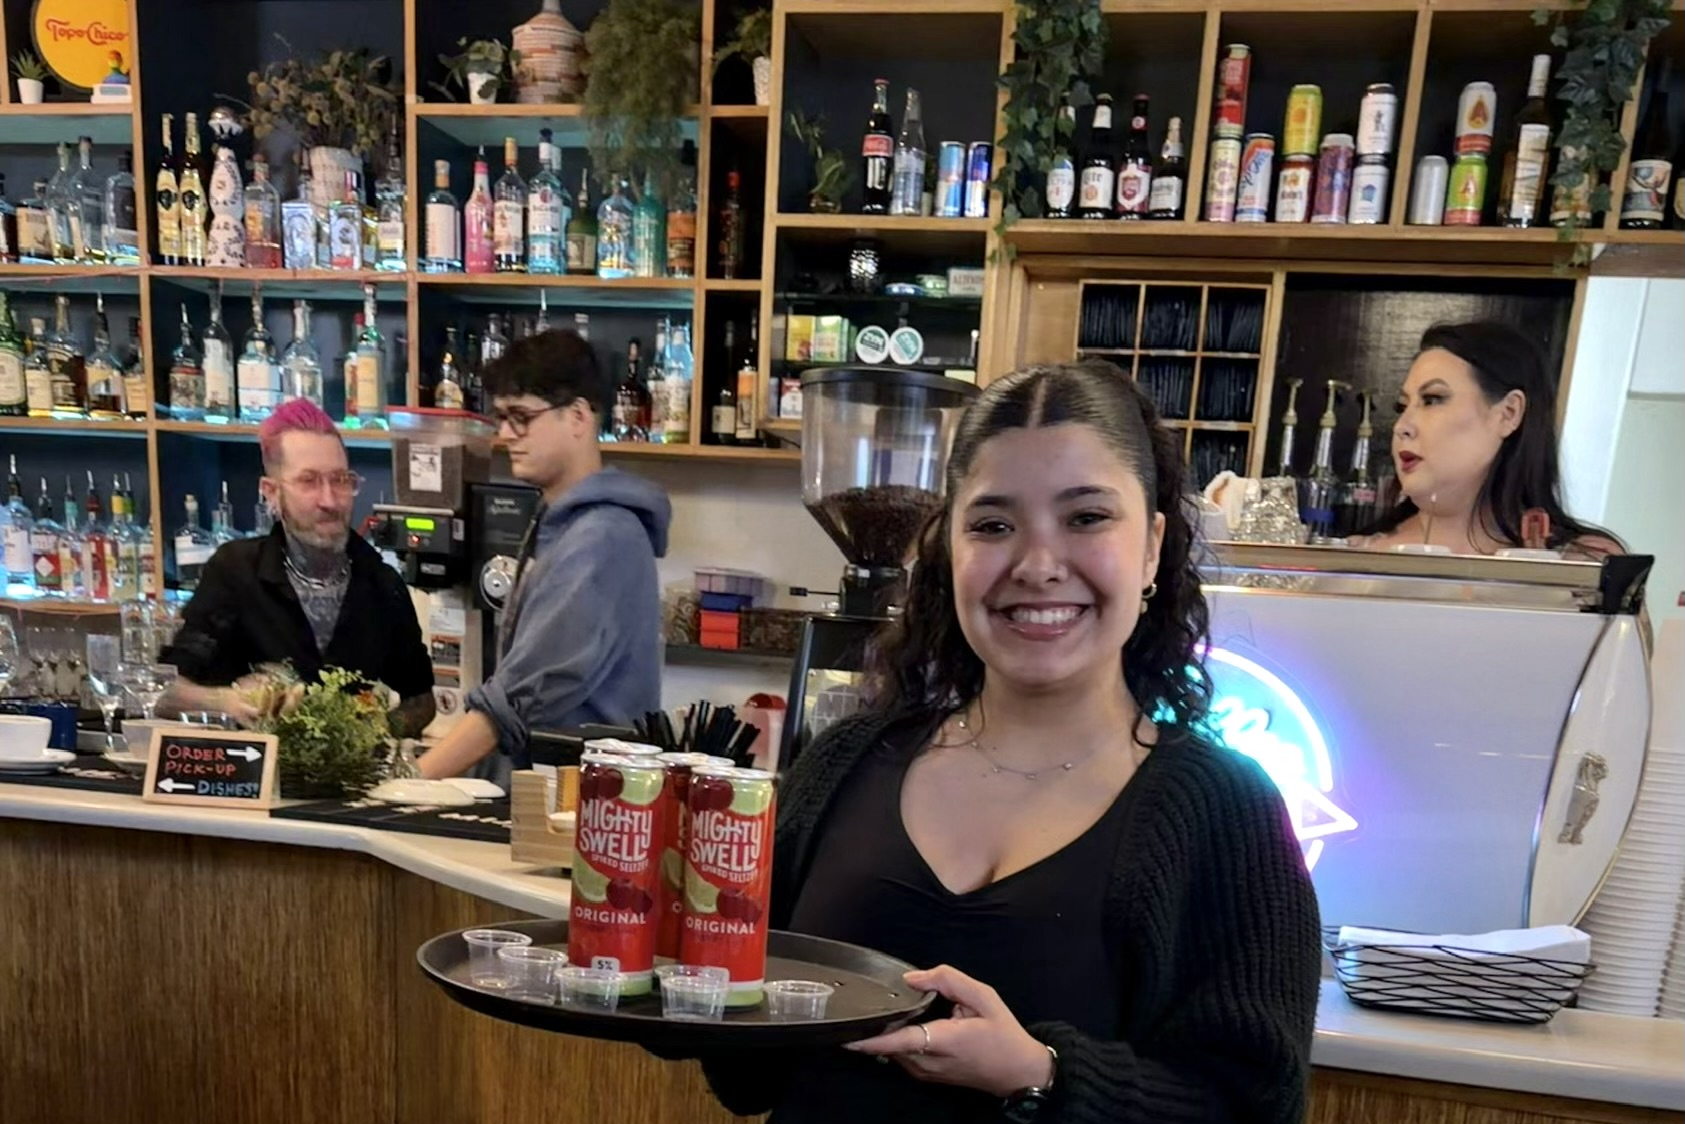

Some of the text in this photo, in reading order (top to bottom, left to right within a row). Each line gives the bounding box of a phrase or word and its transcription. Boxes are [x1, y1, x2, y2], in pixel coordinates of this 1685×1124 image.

[45, 19, 129, 45] Topo Chico
[166, 744, 226, 761] ORDER
[165, 761, 237, 776] PICK-UP
[197, 780, 259, 798] DISHES!
[581, 799, 653, 849] MIGHTY
[691, 809, 762, 859] MIGHTY
[580, 827, 648, 862] SWELL
[690, 838, 757, 872] SWELL
[575, 906, 646, 925] ORIGINAL
[686, 916, 756, 935] ORIGINAL
[597, 960, 613, 971] 5%
